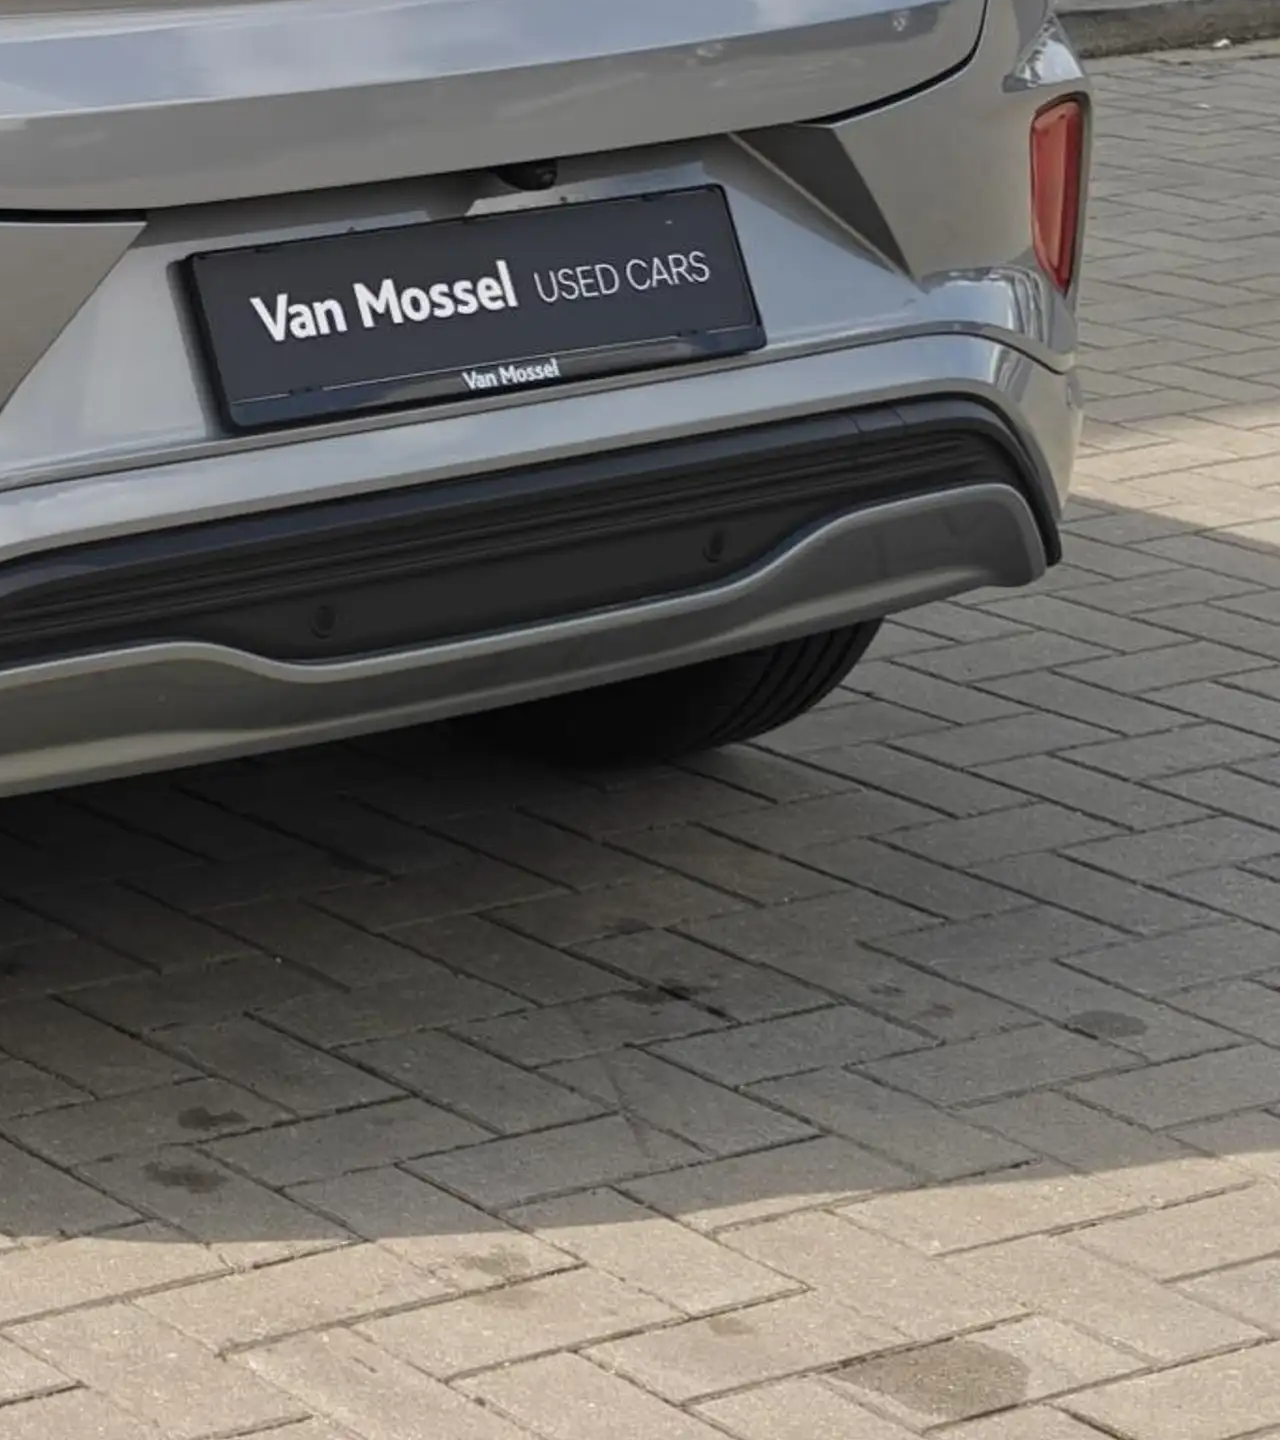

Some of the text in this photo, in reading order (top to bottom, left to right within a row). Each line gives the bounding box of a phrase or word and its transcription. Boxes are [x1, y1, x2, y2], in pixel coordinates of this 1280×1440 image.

[250, 250, 711, 343] Van Mossel USED CARS
[462, 358, 560, 390] Van Mossel
